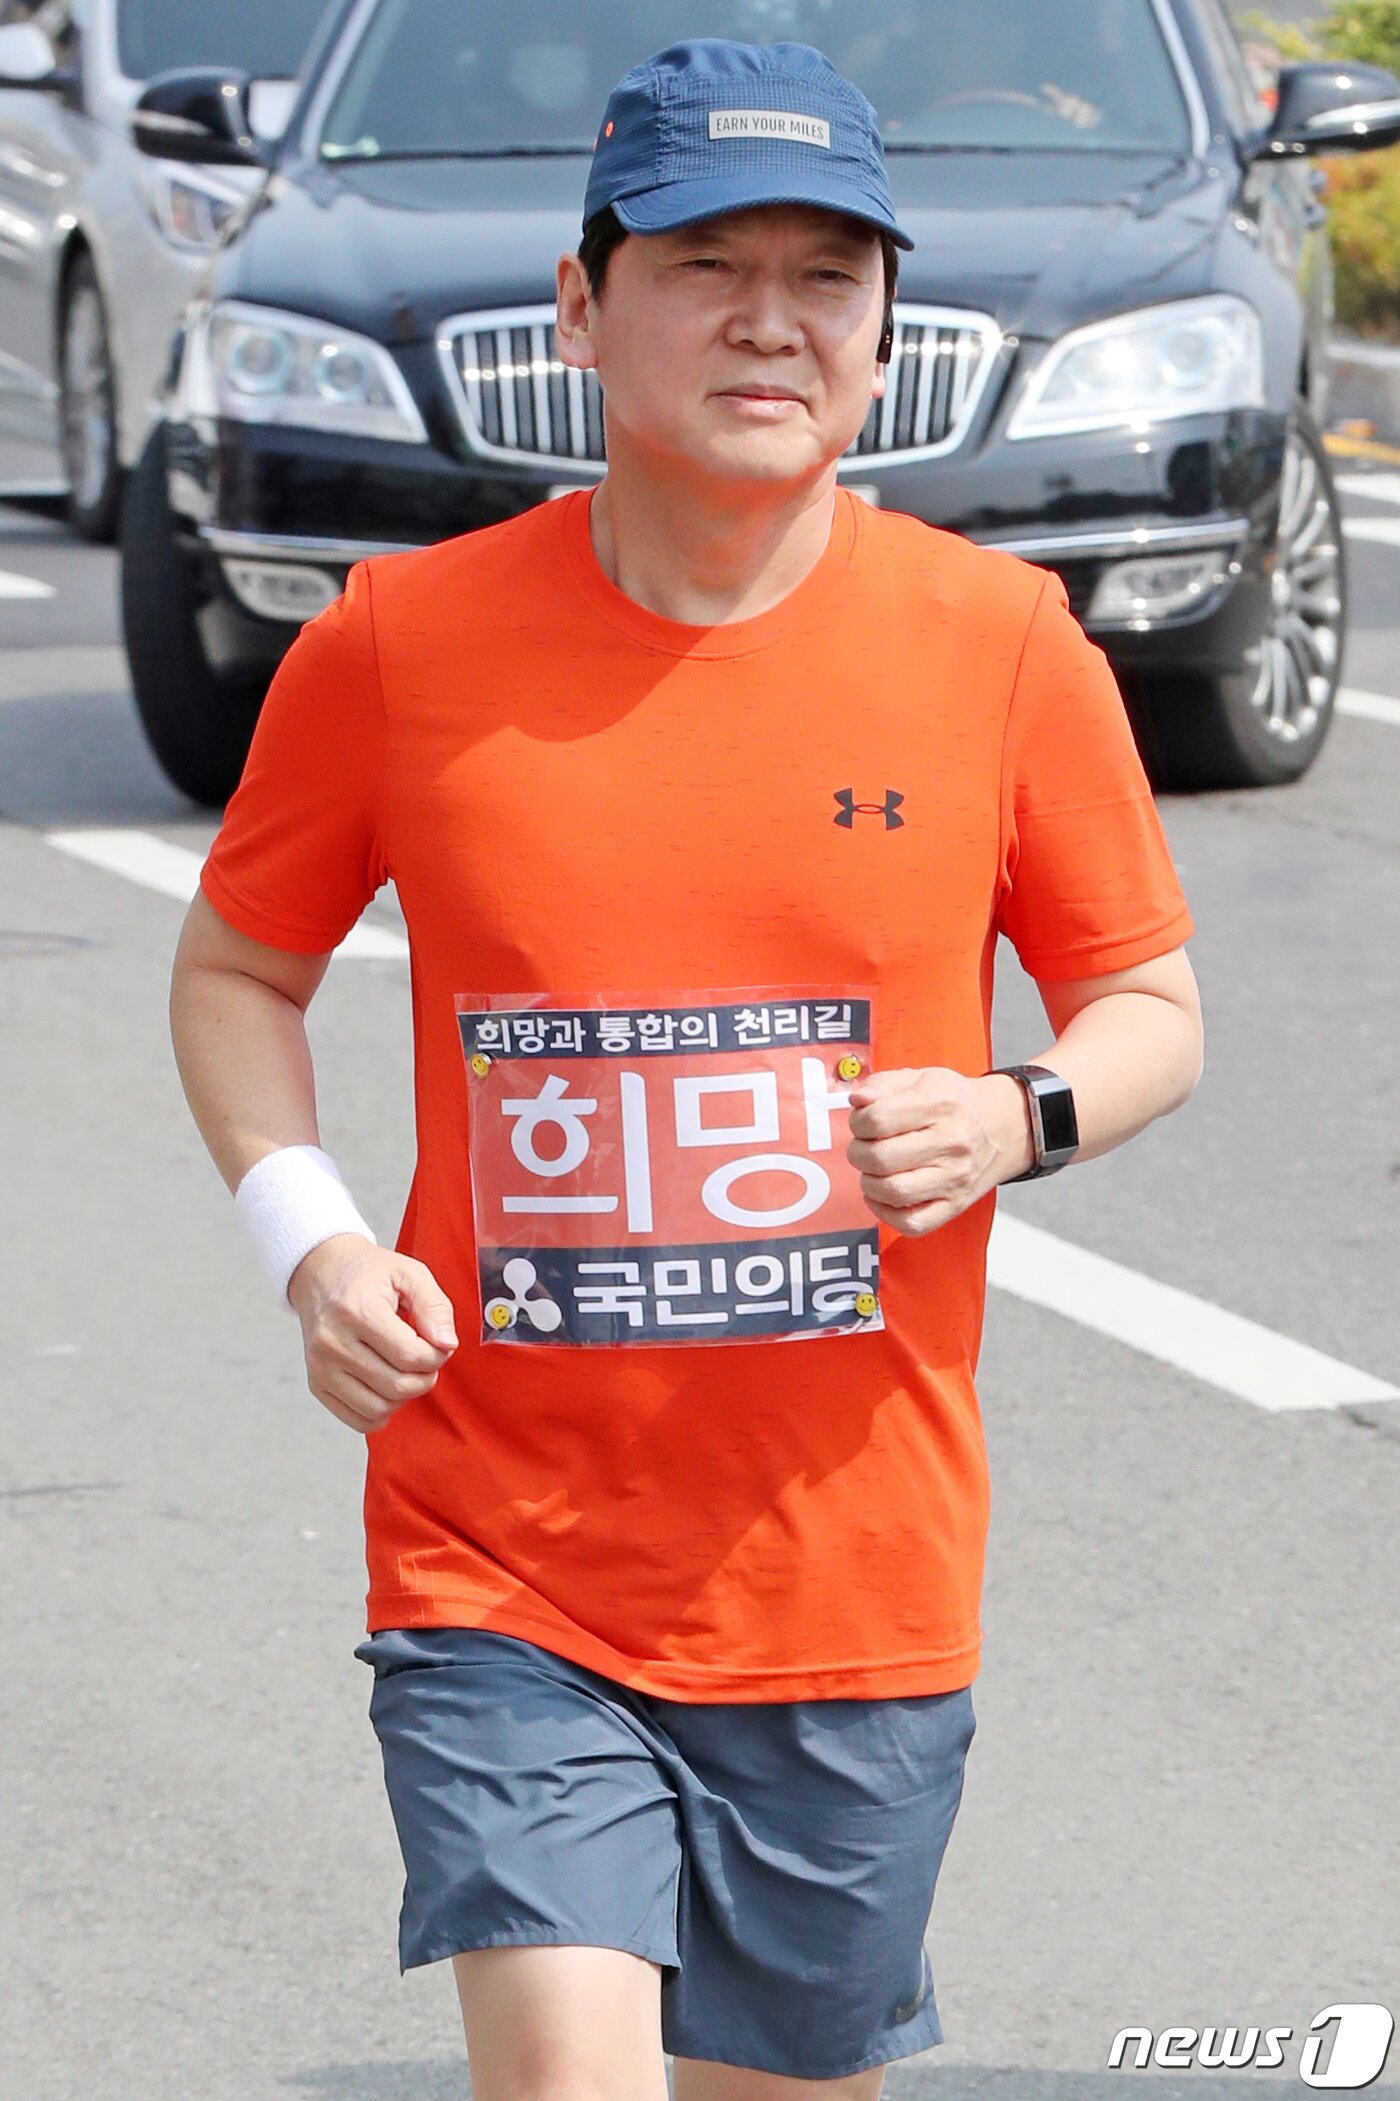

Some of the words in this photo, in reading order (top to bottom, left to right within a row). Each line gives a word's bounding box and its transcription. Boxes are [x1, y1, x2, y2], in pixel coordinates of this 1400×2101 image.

[716, 117, 748, 132] EARN
[752, 117, 786, 133] YOUR
[790, 121, 824, 140] MILES
[475, 1018, 586, 1053] 희망과
[596, 1012, 718, 1052] 통합의
[733, 1004, 853, 1046] 천리길
[501, 1057, 852, 1233] 희망
[573, 1244, 879, 1327] 국민의당
